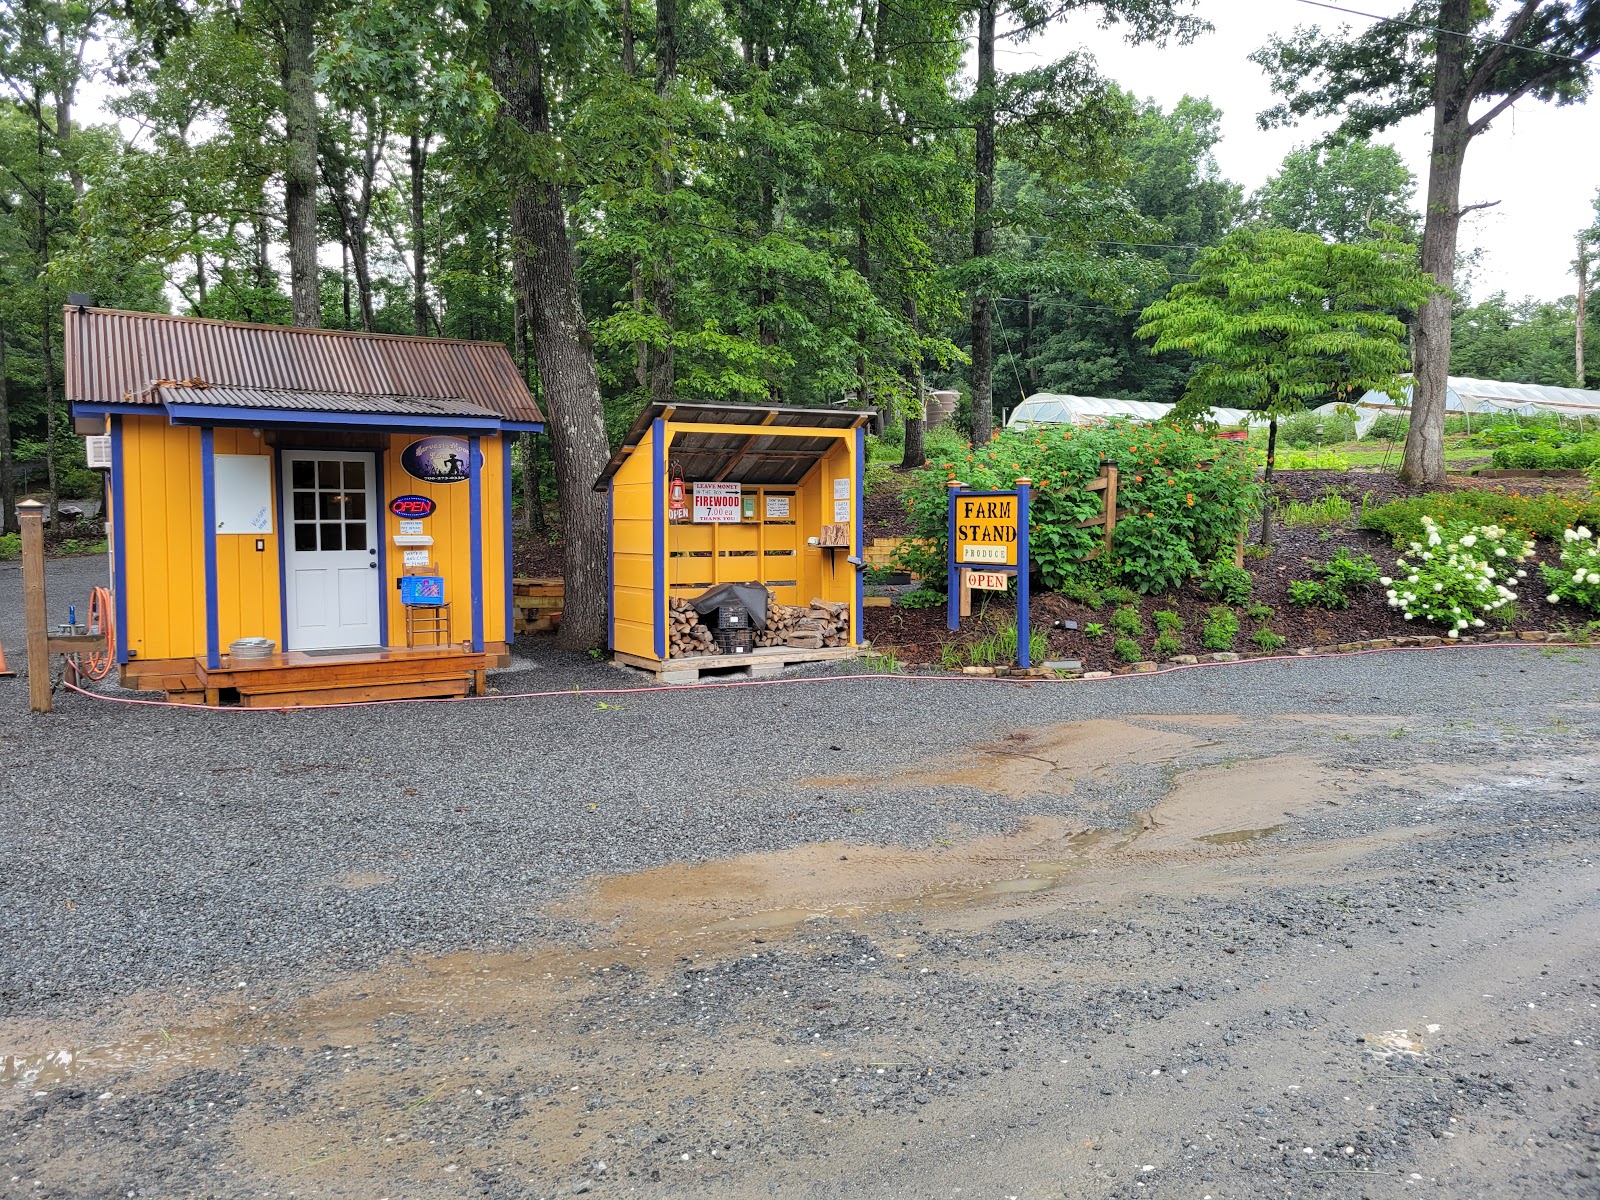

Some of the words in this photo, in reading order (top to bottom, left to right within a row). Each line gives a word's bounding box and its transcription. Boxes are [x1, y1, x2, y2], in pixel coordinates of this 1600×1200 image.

[416, 442, 445, 456] Harvest
[392, 501, 431, 512] OPEN
[695, 496, 739, 507] FIREWOOD
[668, 508, 689, 520] OPEN
[706, 507, 723, 516] 7.00
[964, 502, 1010, 518] FARM
[958, 525, 1017, 542] STAND
[965, 549, 1005, 558] PRODUCE
[968, 574, 1003, 588] OPEN
